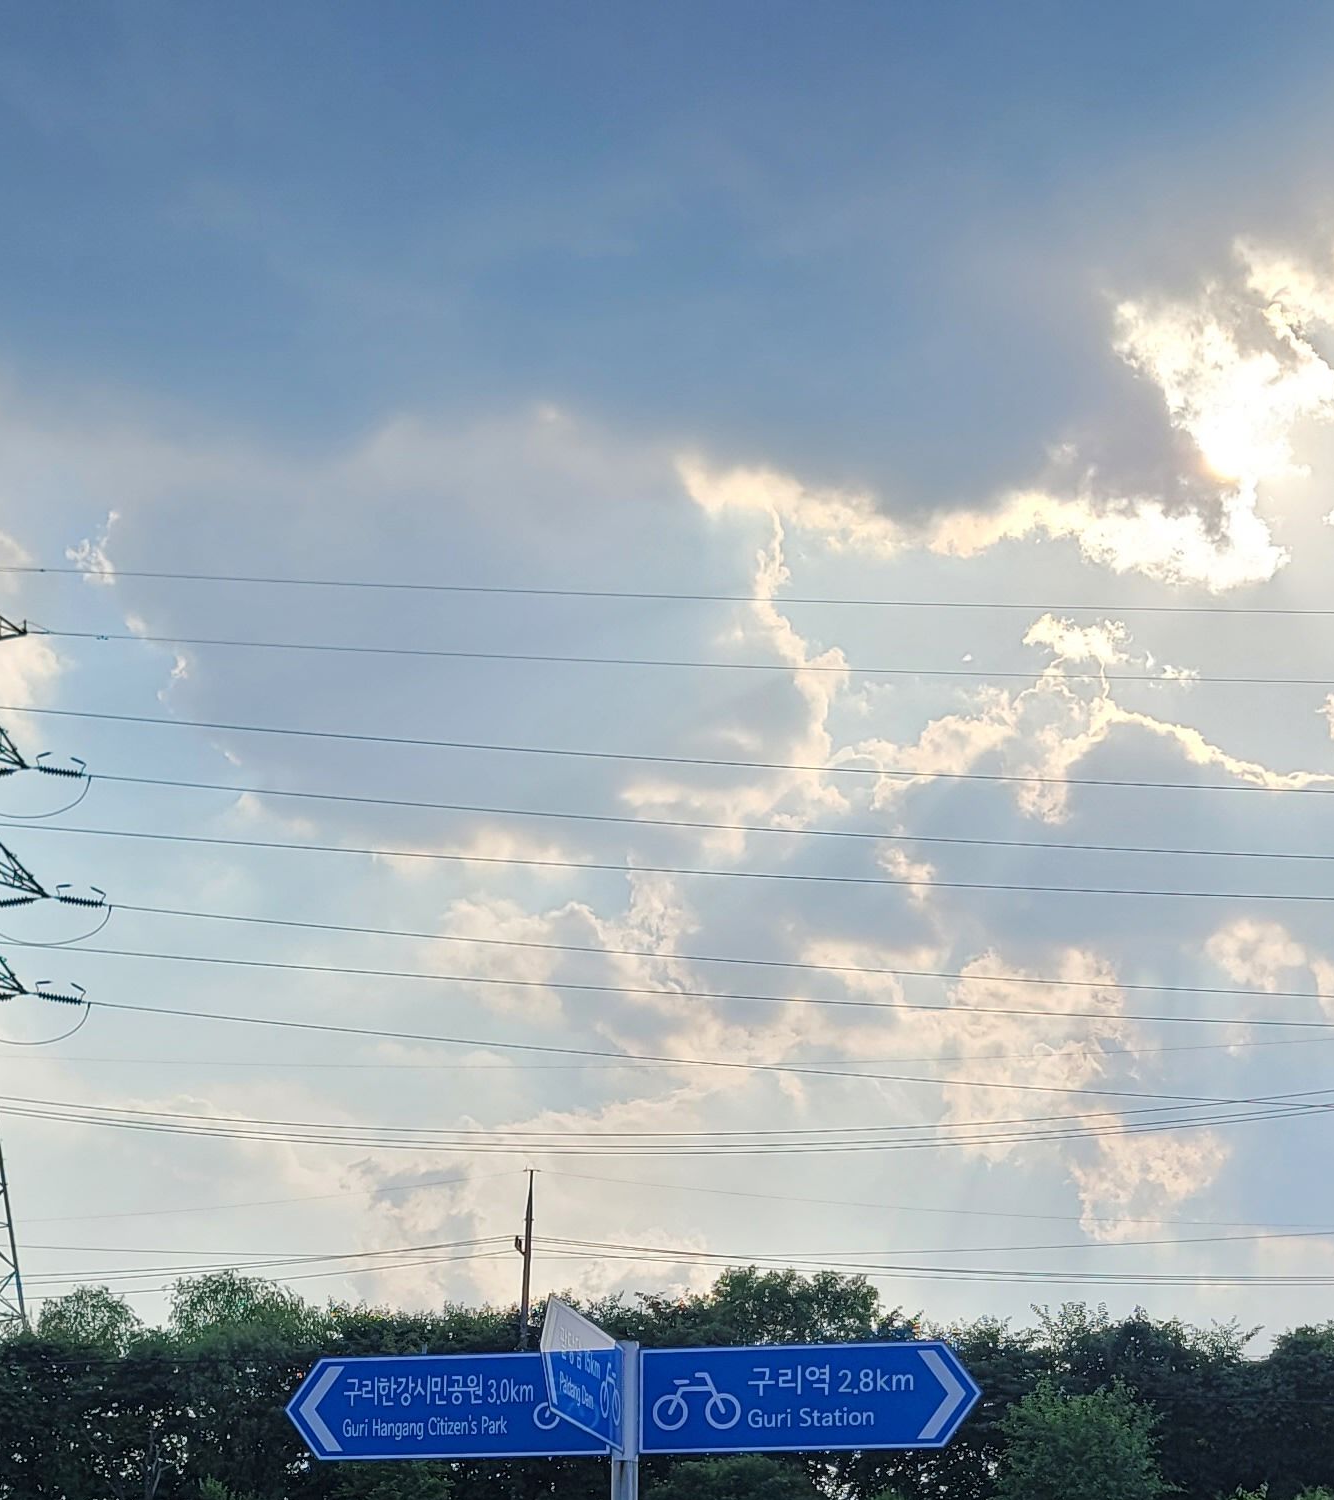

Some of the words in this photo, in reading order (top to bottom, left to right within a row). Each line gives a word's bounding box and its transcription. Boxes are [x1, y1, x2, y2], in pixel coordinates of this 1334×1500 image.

[343, 1374, 483, 1407] 구리한강시민공원
[487, 1379, 534, 1406] 3.0km
[559, 1370, 581, 1407] Paldang
[581, 1384, 594, 1410] Dam
[747, 1364, 830, 1397] 구리역
[838, 1368, 914, 1395] 2.8km
[342, 1418, 368, 1437] Guri
[372, 1418, 424, 1441] Hangang
[428, 1414, 477, 1436] Citizen's
[481, 1415, 508, 1435] Park
[747, 1408, 792, 1428] Guri
[799, 1407, 875, 1427] Station
